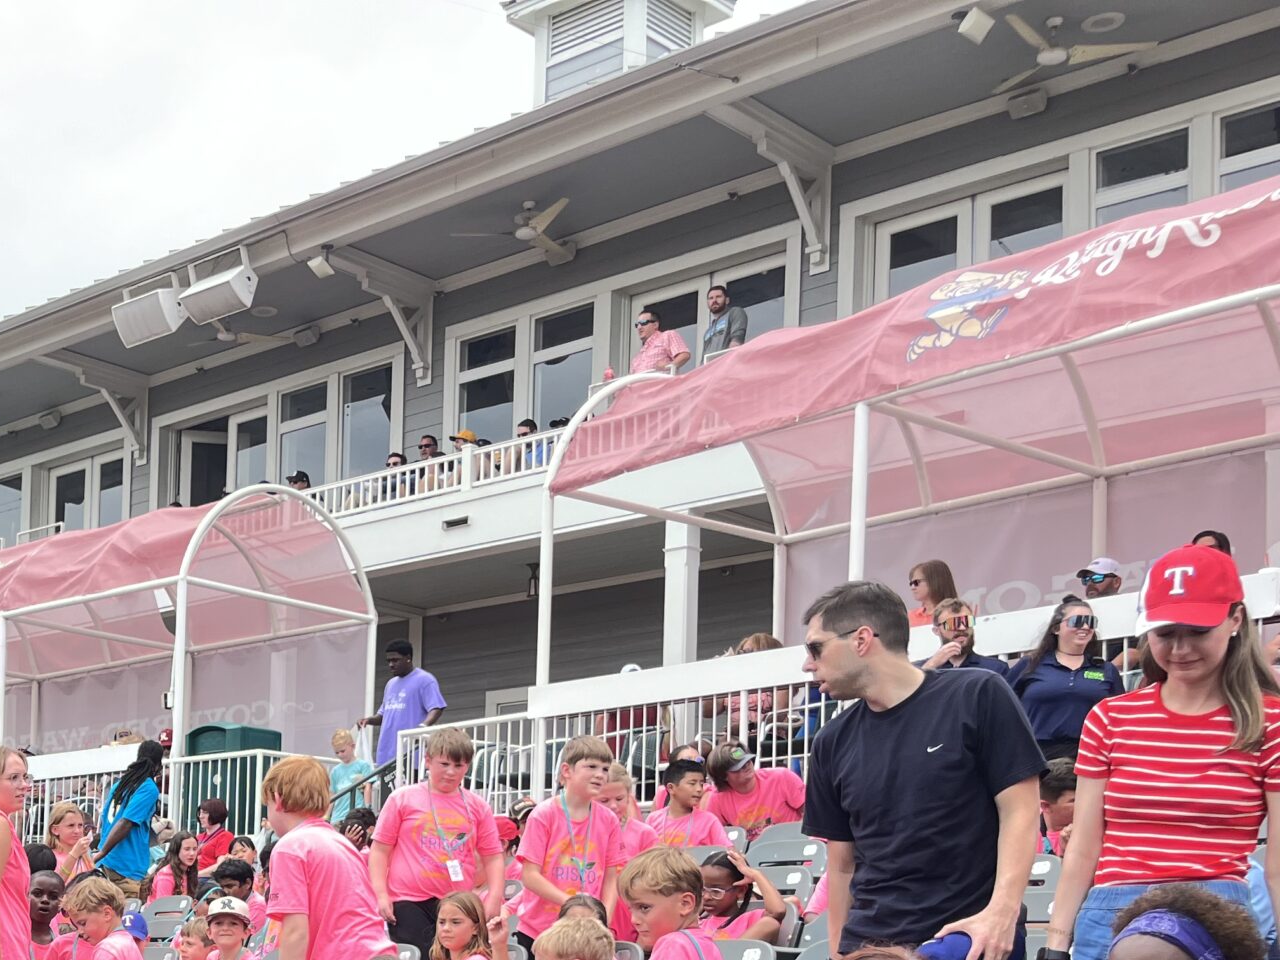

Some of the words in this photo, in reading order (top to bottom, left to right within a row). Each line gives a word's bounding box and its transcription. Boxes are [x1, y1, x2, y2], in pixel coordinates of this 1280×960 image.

[1164, 566, 1194, 595] T
[220, 898, 235, 910] R
[122, 914, 134, 926] T
